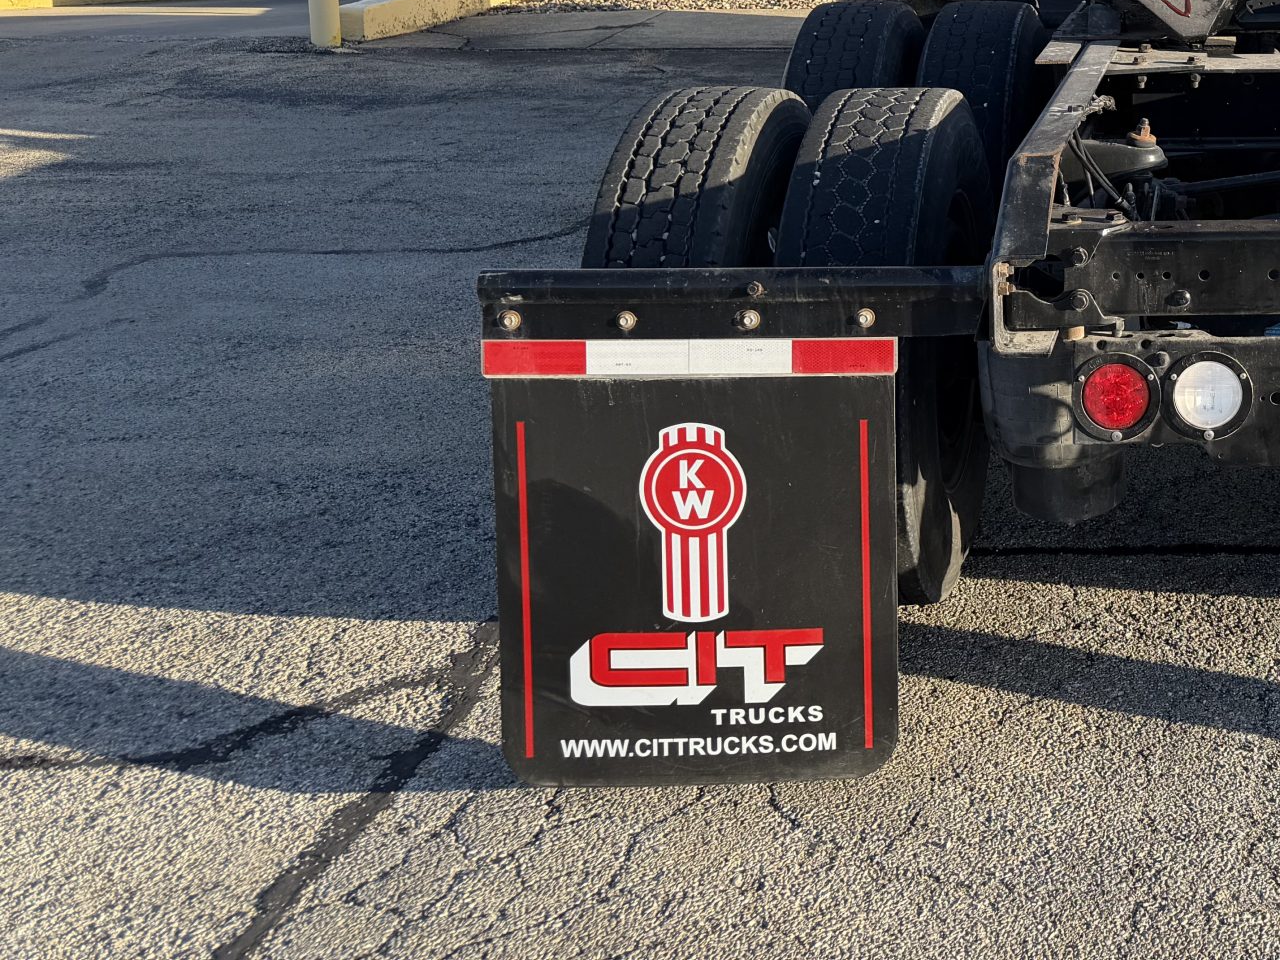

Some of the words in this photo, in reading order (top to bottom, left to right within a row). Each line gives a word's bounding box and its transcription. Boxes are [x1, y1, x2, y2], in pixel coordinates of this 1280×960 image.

[569, 627, 825, 707] CIT
[710, 705, 824, 726] TRUCKS
[560, 732, 838, 758] WWW.CITTRUCKS.COM
